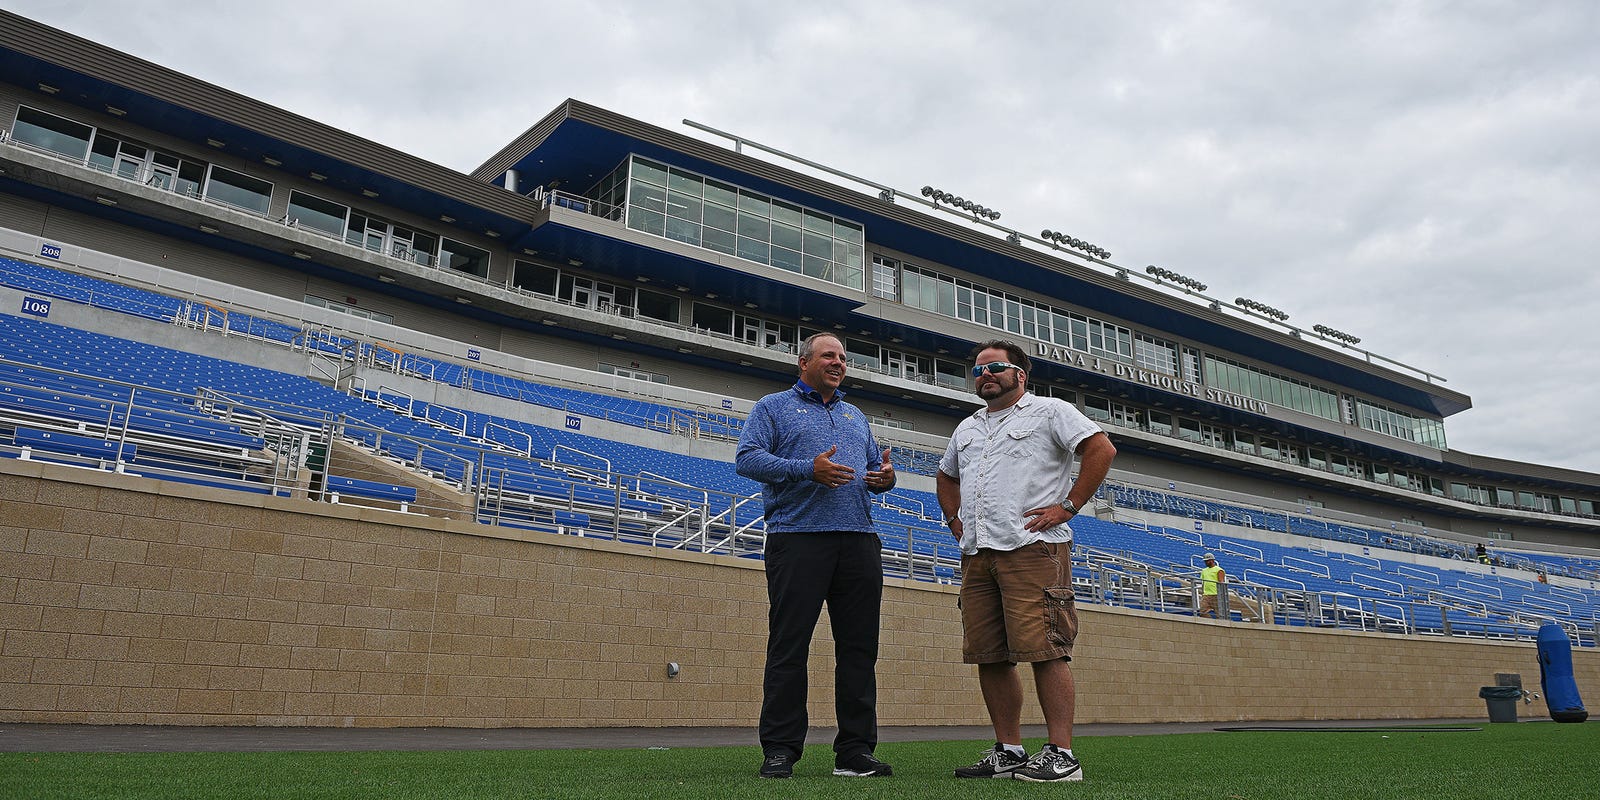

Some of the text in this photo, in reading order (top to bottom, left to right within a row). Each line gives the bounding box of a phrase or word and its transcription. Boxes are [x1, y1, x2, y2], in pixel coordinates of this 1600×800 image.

[42, 246, 60, 257] 208
[23, 300, 49, 314] 108
[1037, 342, 1269, 415] DANA J. DYKHOUSE STADIUM
[566, 418, 580, 428] 107
